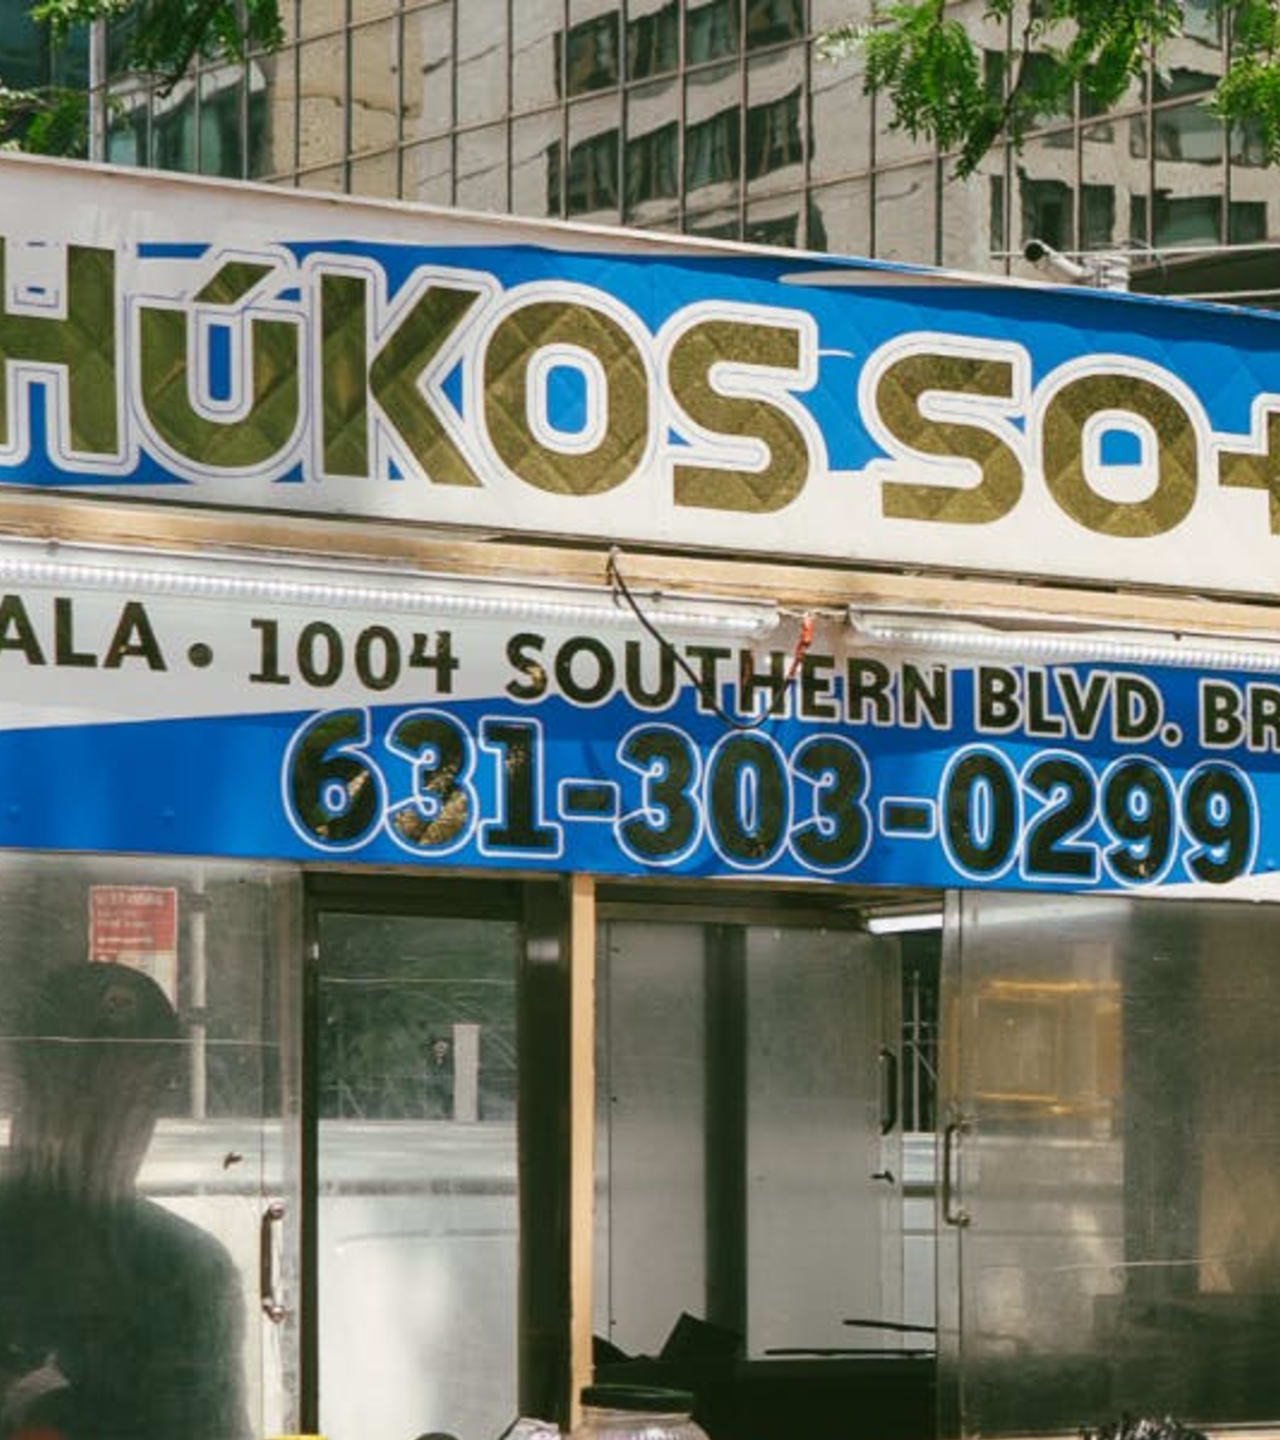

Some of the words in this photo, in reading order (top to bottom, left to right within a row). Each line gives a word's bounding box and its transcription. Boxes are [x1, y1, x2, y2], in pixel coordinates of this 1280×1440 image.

[247, 618, 460, 695] 1004
[506, 633, 955, 729] SOUTHERN
[976, 662, 1182, 750] BLVD.
[287, 704, 1260, 888] 631-303-0299
